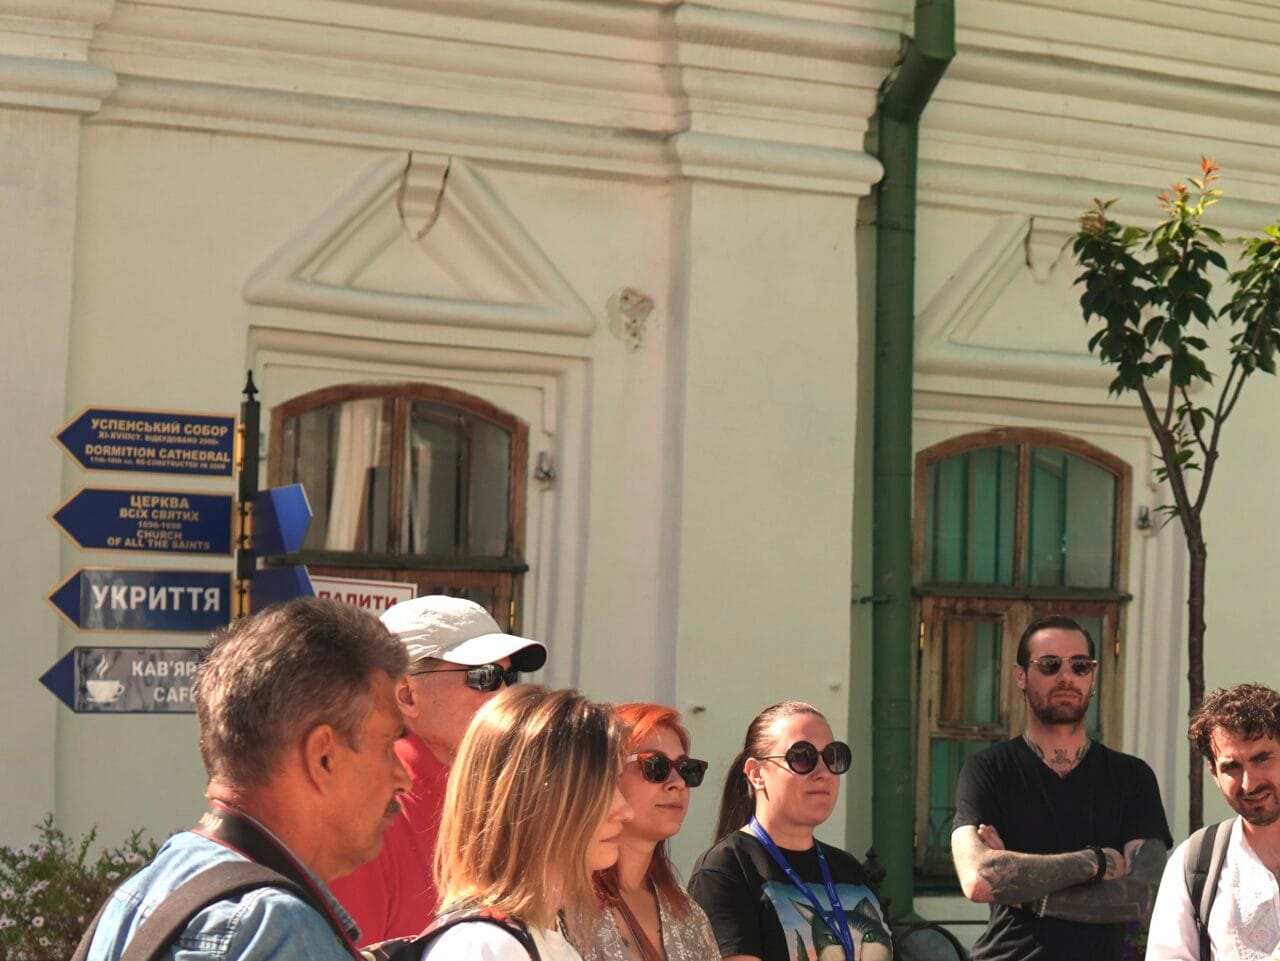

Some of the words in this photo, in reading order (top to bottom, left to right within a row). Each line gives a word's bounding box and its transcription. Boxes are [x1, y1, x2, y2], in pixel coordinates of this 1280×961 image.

[91, 418, 180, 434] УСПЕНСЬКИЙ
[184, 424, 228, 437] СОБОР
[85, 444, 156, 458] DORMITION
[159, 448, 231, 462] CATHEDRAL
[130, 495, 190, 508] ЦЕРКВА
[151, 509, 200, 520] СВЯТИХ
[136, 529, 182, 539] CHURCH
[107, 537, 121, 546] OF
[124, 538, 145, 547] ALL
[148, 540, 169, 549] THE
[172, 541, 210, 550] SAINTS
[91, 585, 220, 611] УКРИТТЯ
[131, 660, 198, 678] КАВ'ЯР
